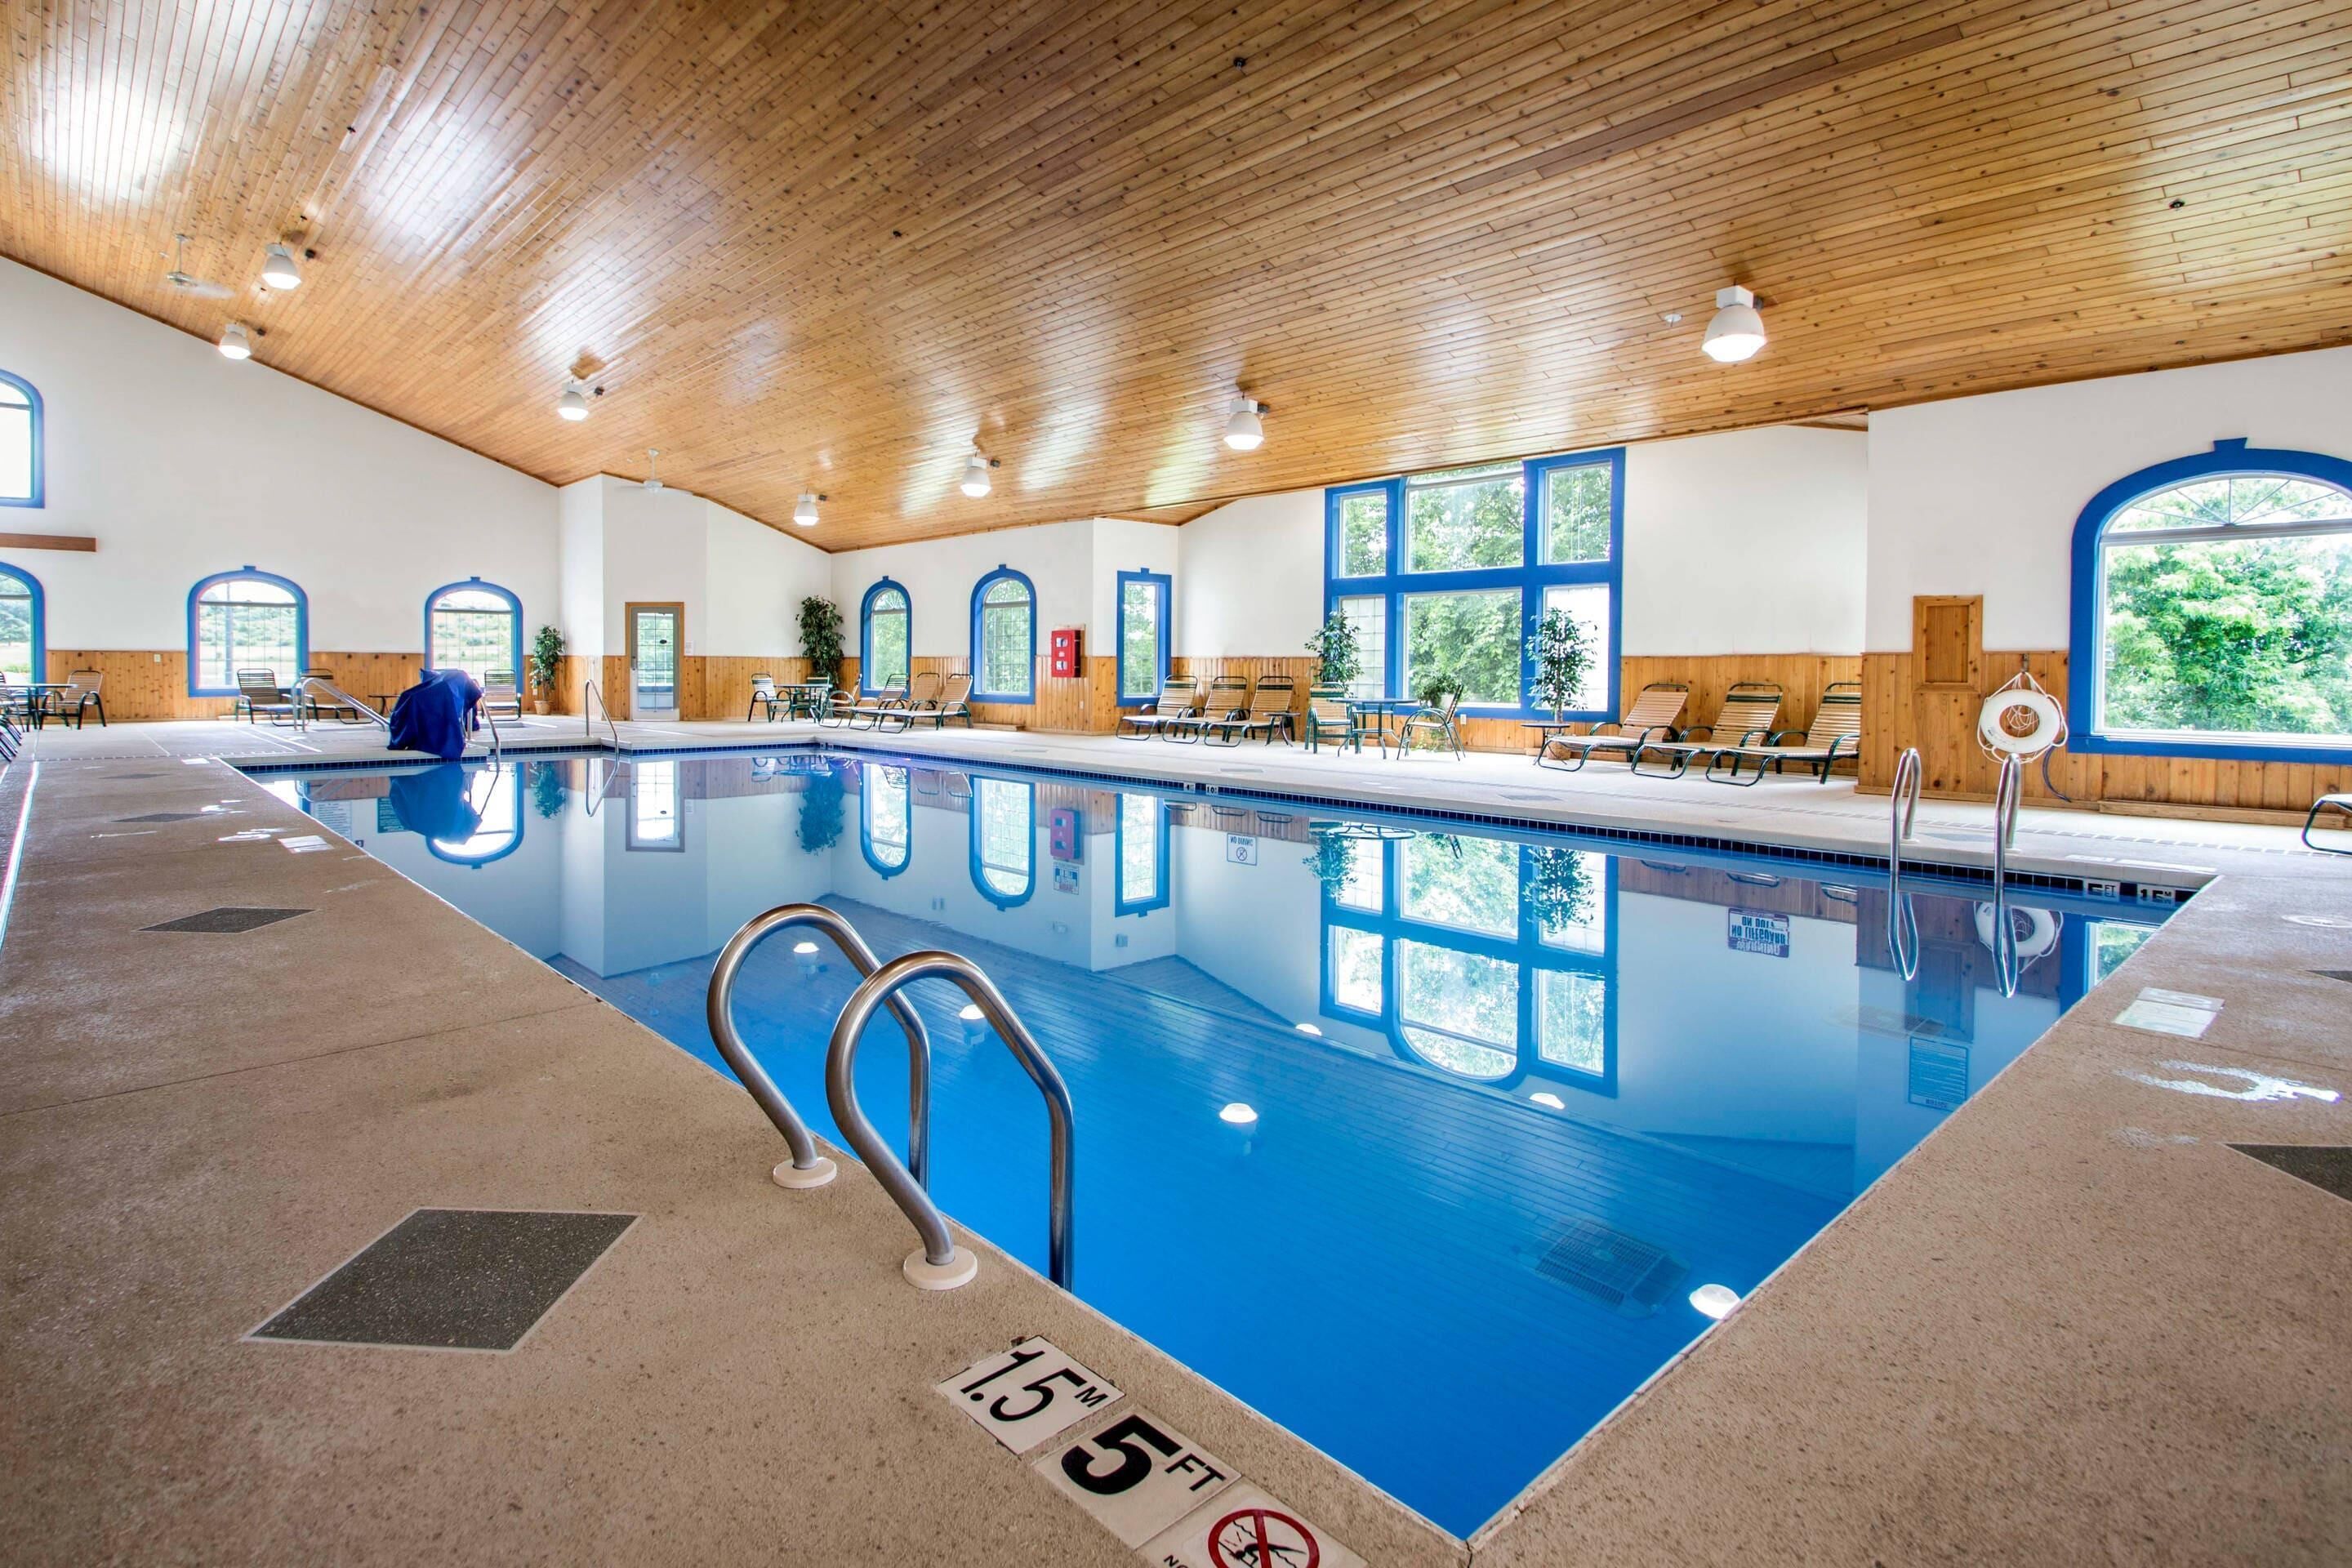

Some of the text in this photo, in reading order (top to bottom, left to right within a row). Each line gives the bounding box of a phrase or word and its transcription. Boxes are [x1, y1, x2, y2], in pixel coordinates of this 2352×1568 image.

[960, 1349, 1109, 1422] 1.5 M
[1061, 1414, 1226, 1494] 5 FT
